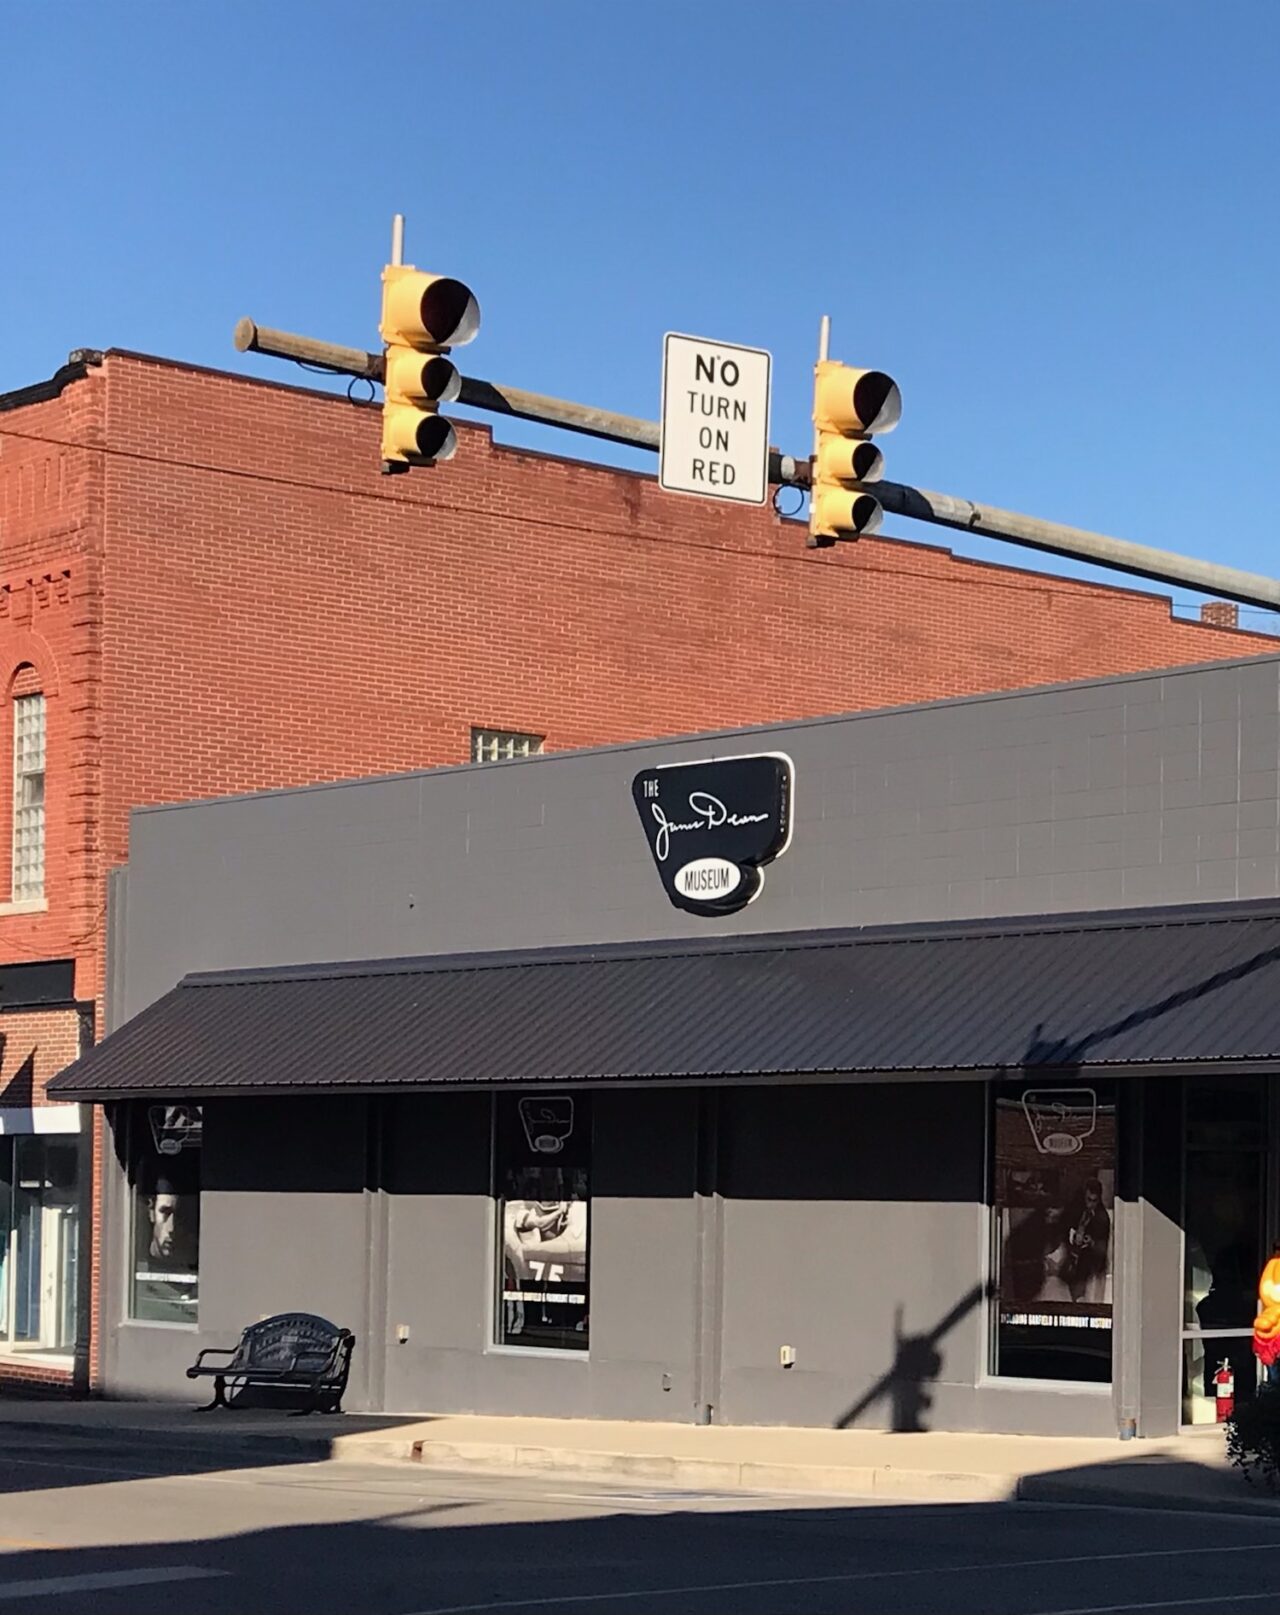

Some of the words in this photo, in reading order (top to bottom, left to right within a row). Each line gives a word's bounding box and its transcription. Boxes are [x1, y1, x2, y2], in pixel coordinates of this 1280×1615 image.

[695, 353, 739, 387] NO
[687, 390, 747, 423] TURN
[699, 426, 729, 452] ON
[692, 458, 736, 486] RED
[643, 779, 660, 798] THE
[689, 791, 769, 831] Dean
[684, 867, 730, 892] MUSEUM
